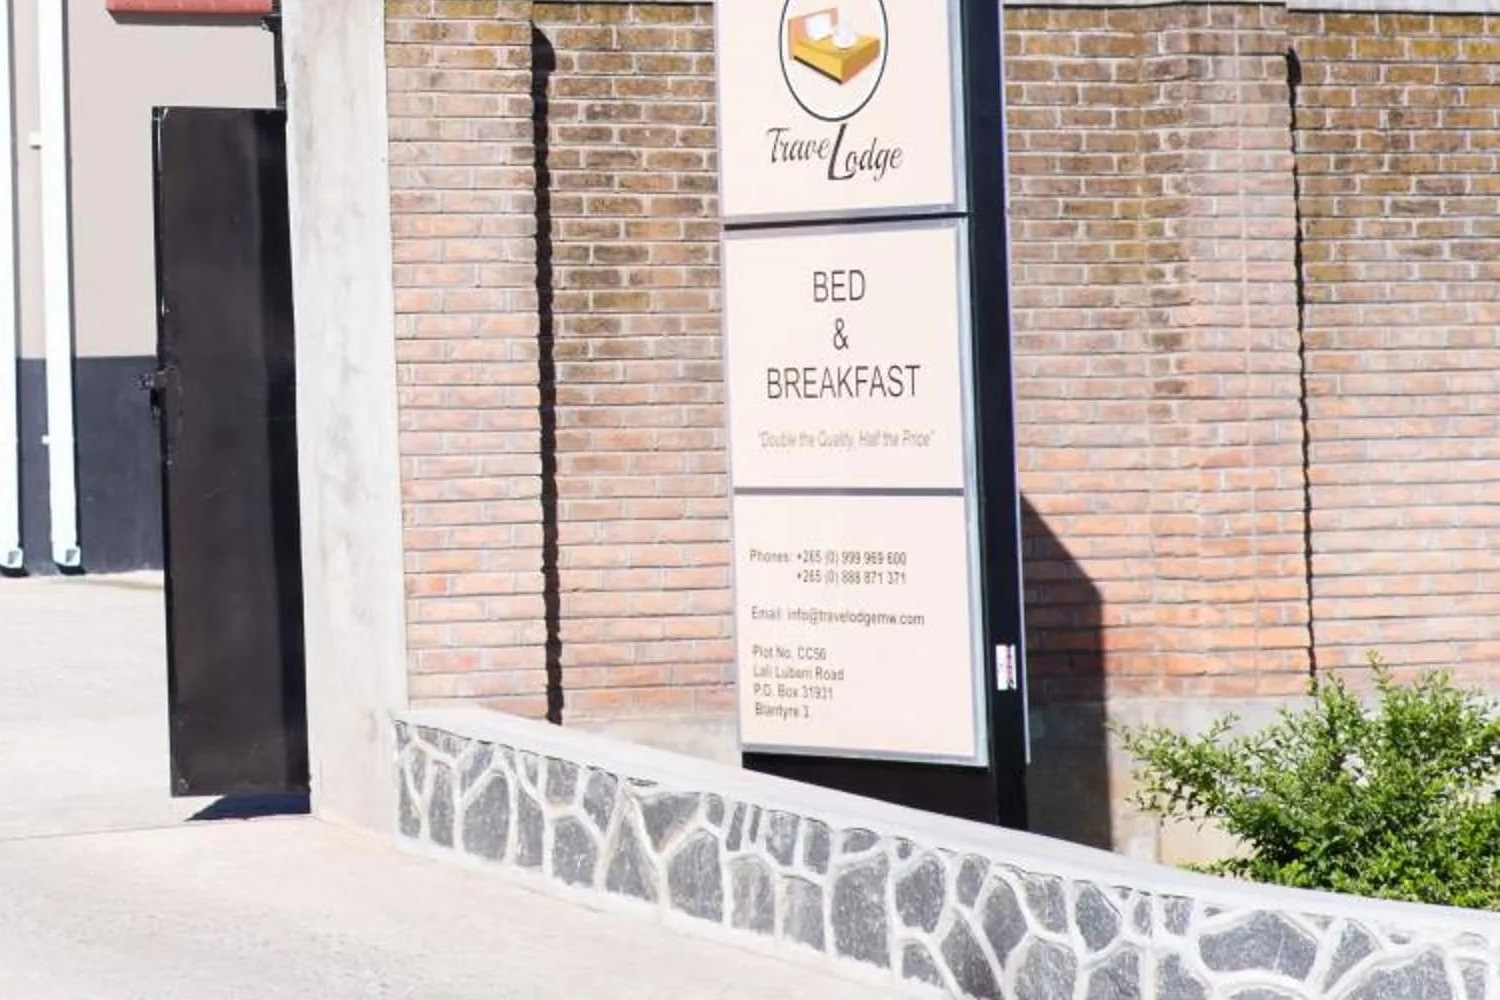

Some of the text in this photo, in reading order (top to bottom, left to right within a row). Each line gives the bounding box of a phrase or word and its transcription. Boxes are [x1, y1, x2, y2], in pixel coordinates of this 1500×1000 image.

[813, 269, 866, 302] BED
[832, 317, 849, 350] &
[767, 364, 921, 399] BREAKFAST
[797, 550, 821, 564] +265
[825, 550, 839, 566] (0)
[797, 569, 821, 584] +265
[825, 570, 839, 585] (0)
[815, 665, 845, 681] Road
[777, 684, 799, 699] Box
